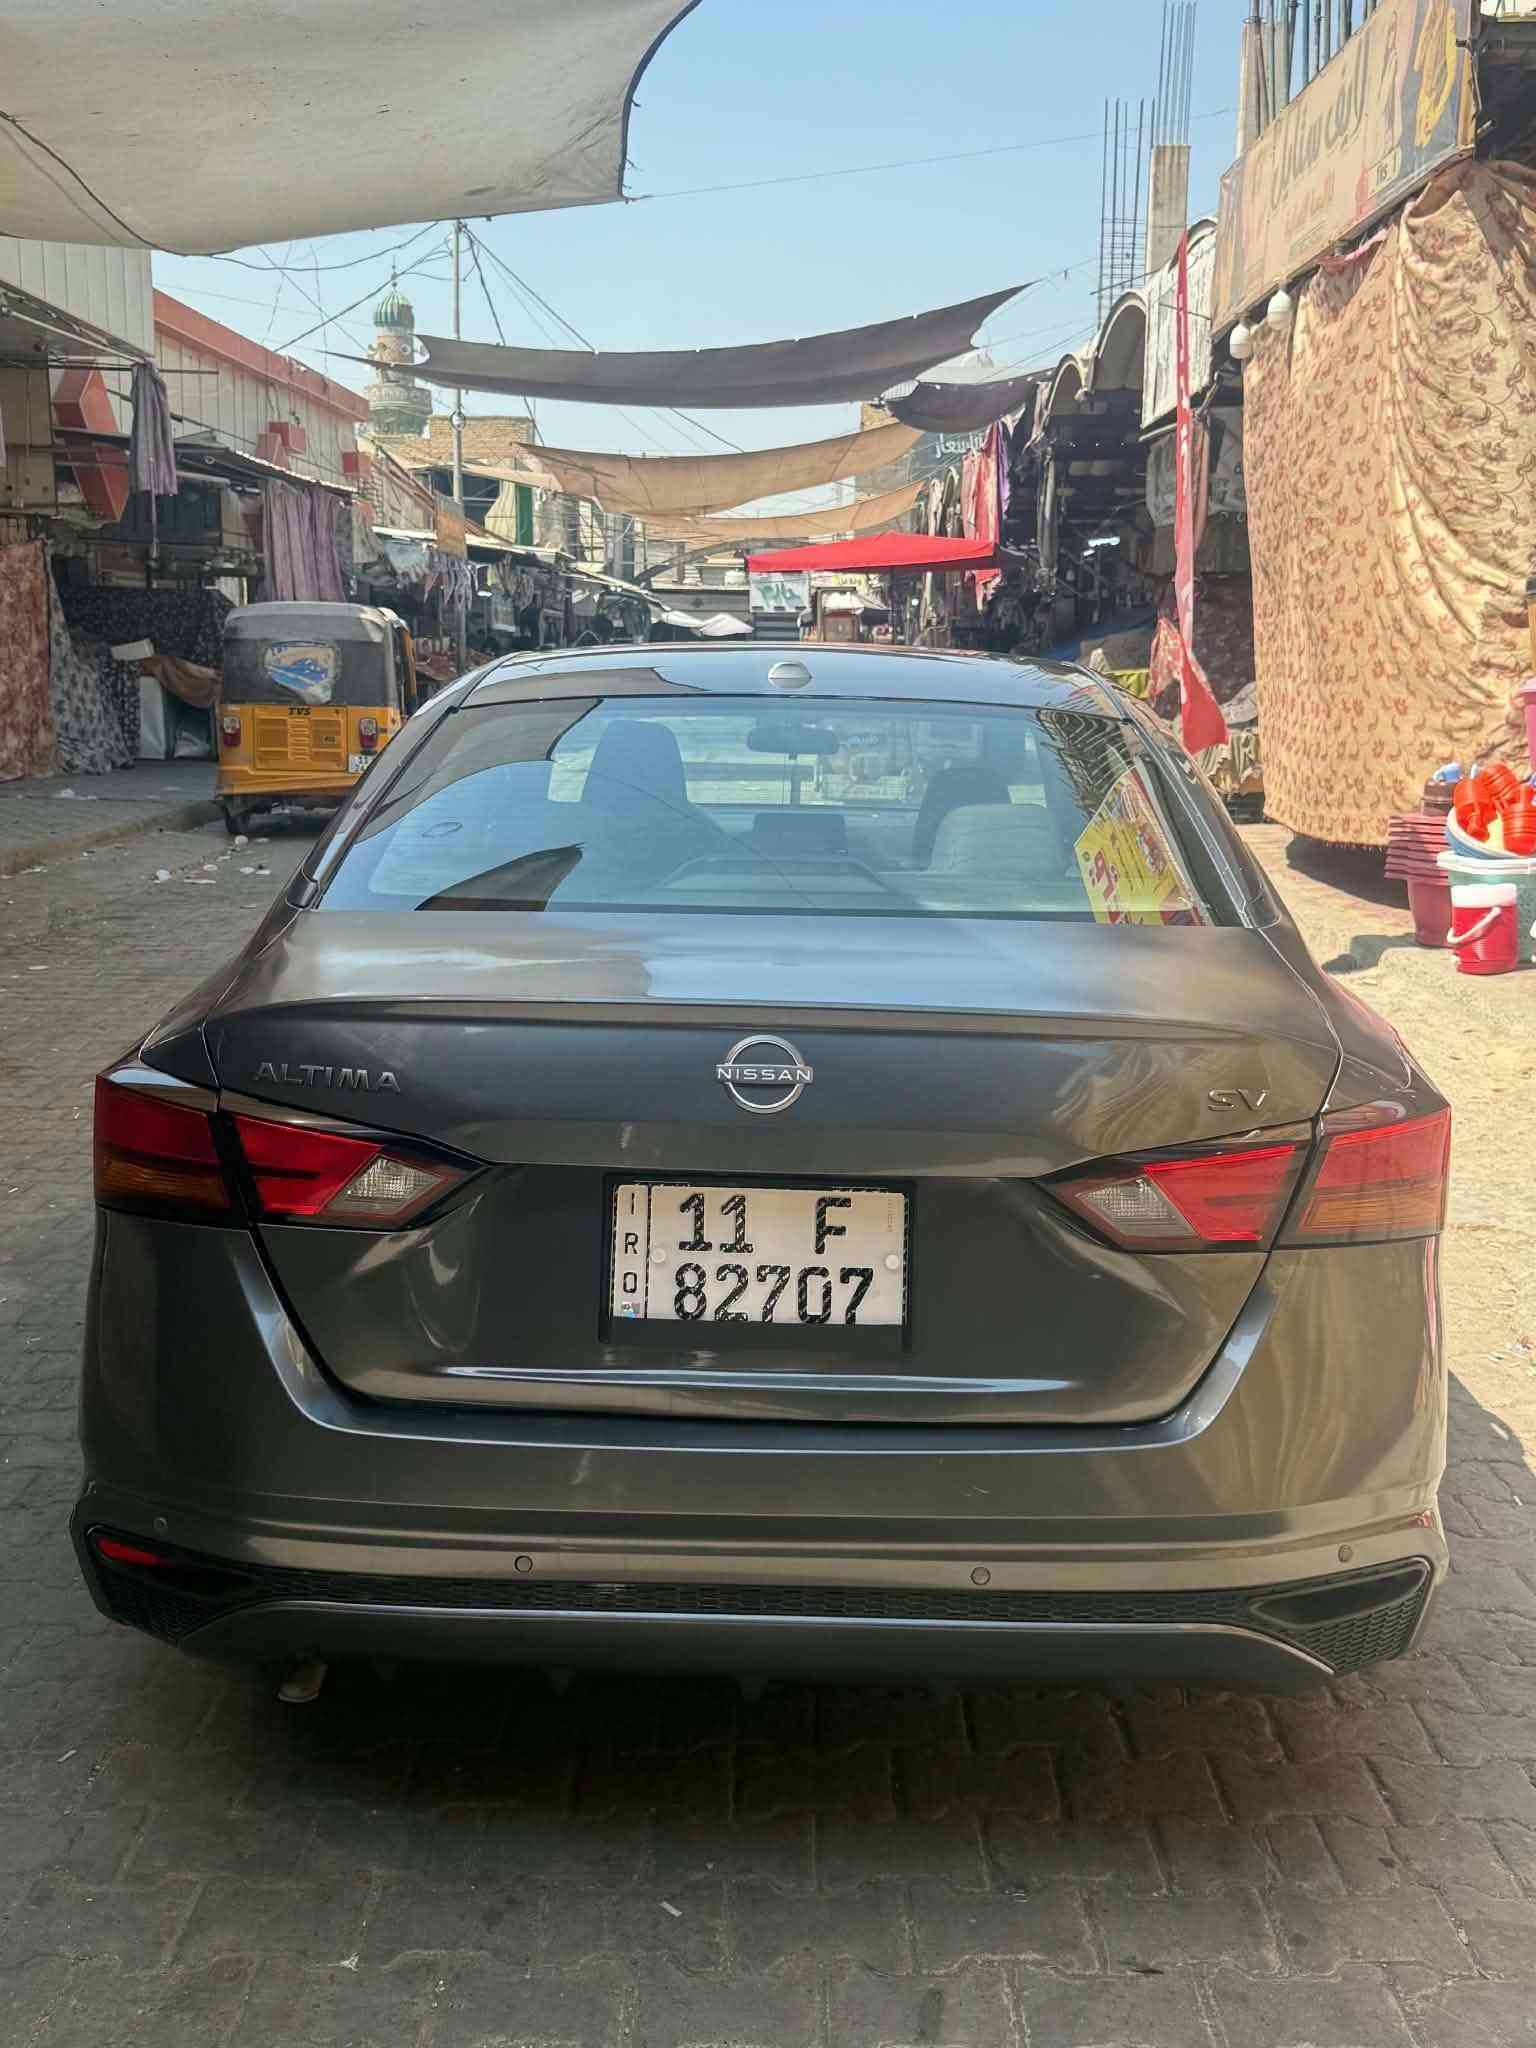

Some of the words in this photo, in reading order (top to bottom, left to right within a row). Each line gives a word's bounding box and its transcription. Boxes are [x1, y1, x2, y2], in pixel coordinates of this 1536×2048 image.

[252, 1062, 400, 1094] ALTIMA
[717, 1068, 811, 1081] NISSAN
[1208, 1088, 1268, 1112] SV
[678, 1193, 753, 1254] 11
[815, 1197, 852, 1255] F
[674, 1262, 873, 1325] 82707
